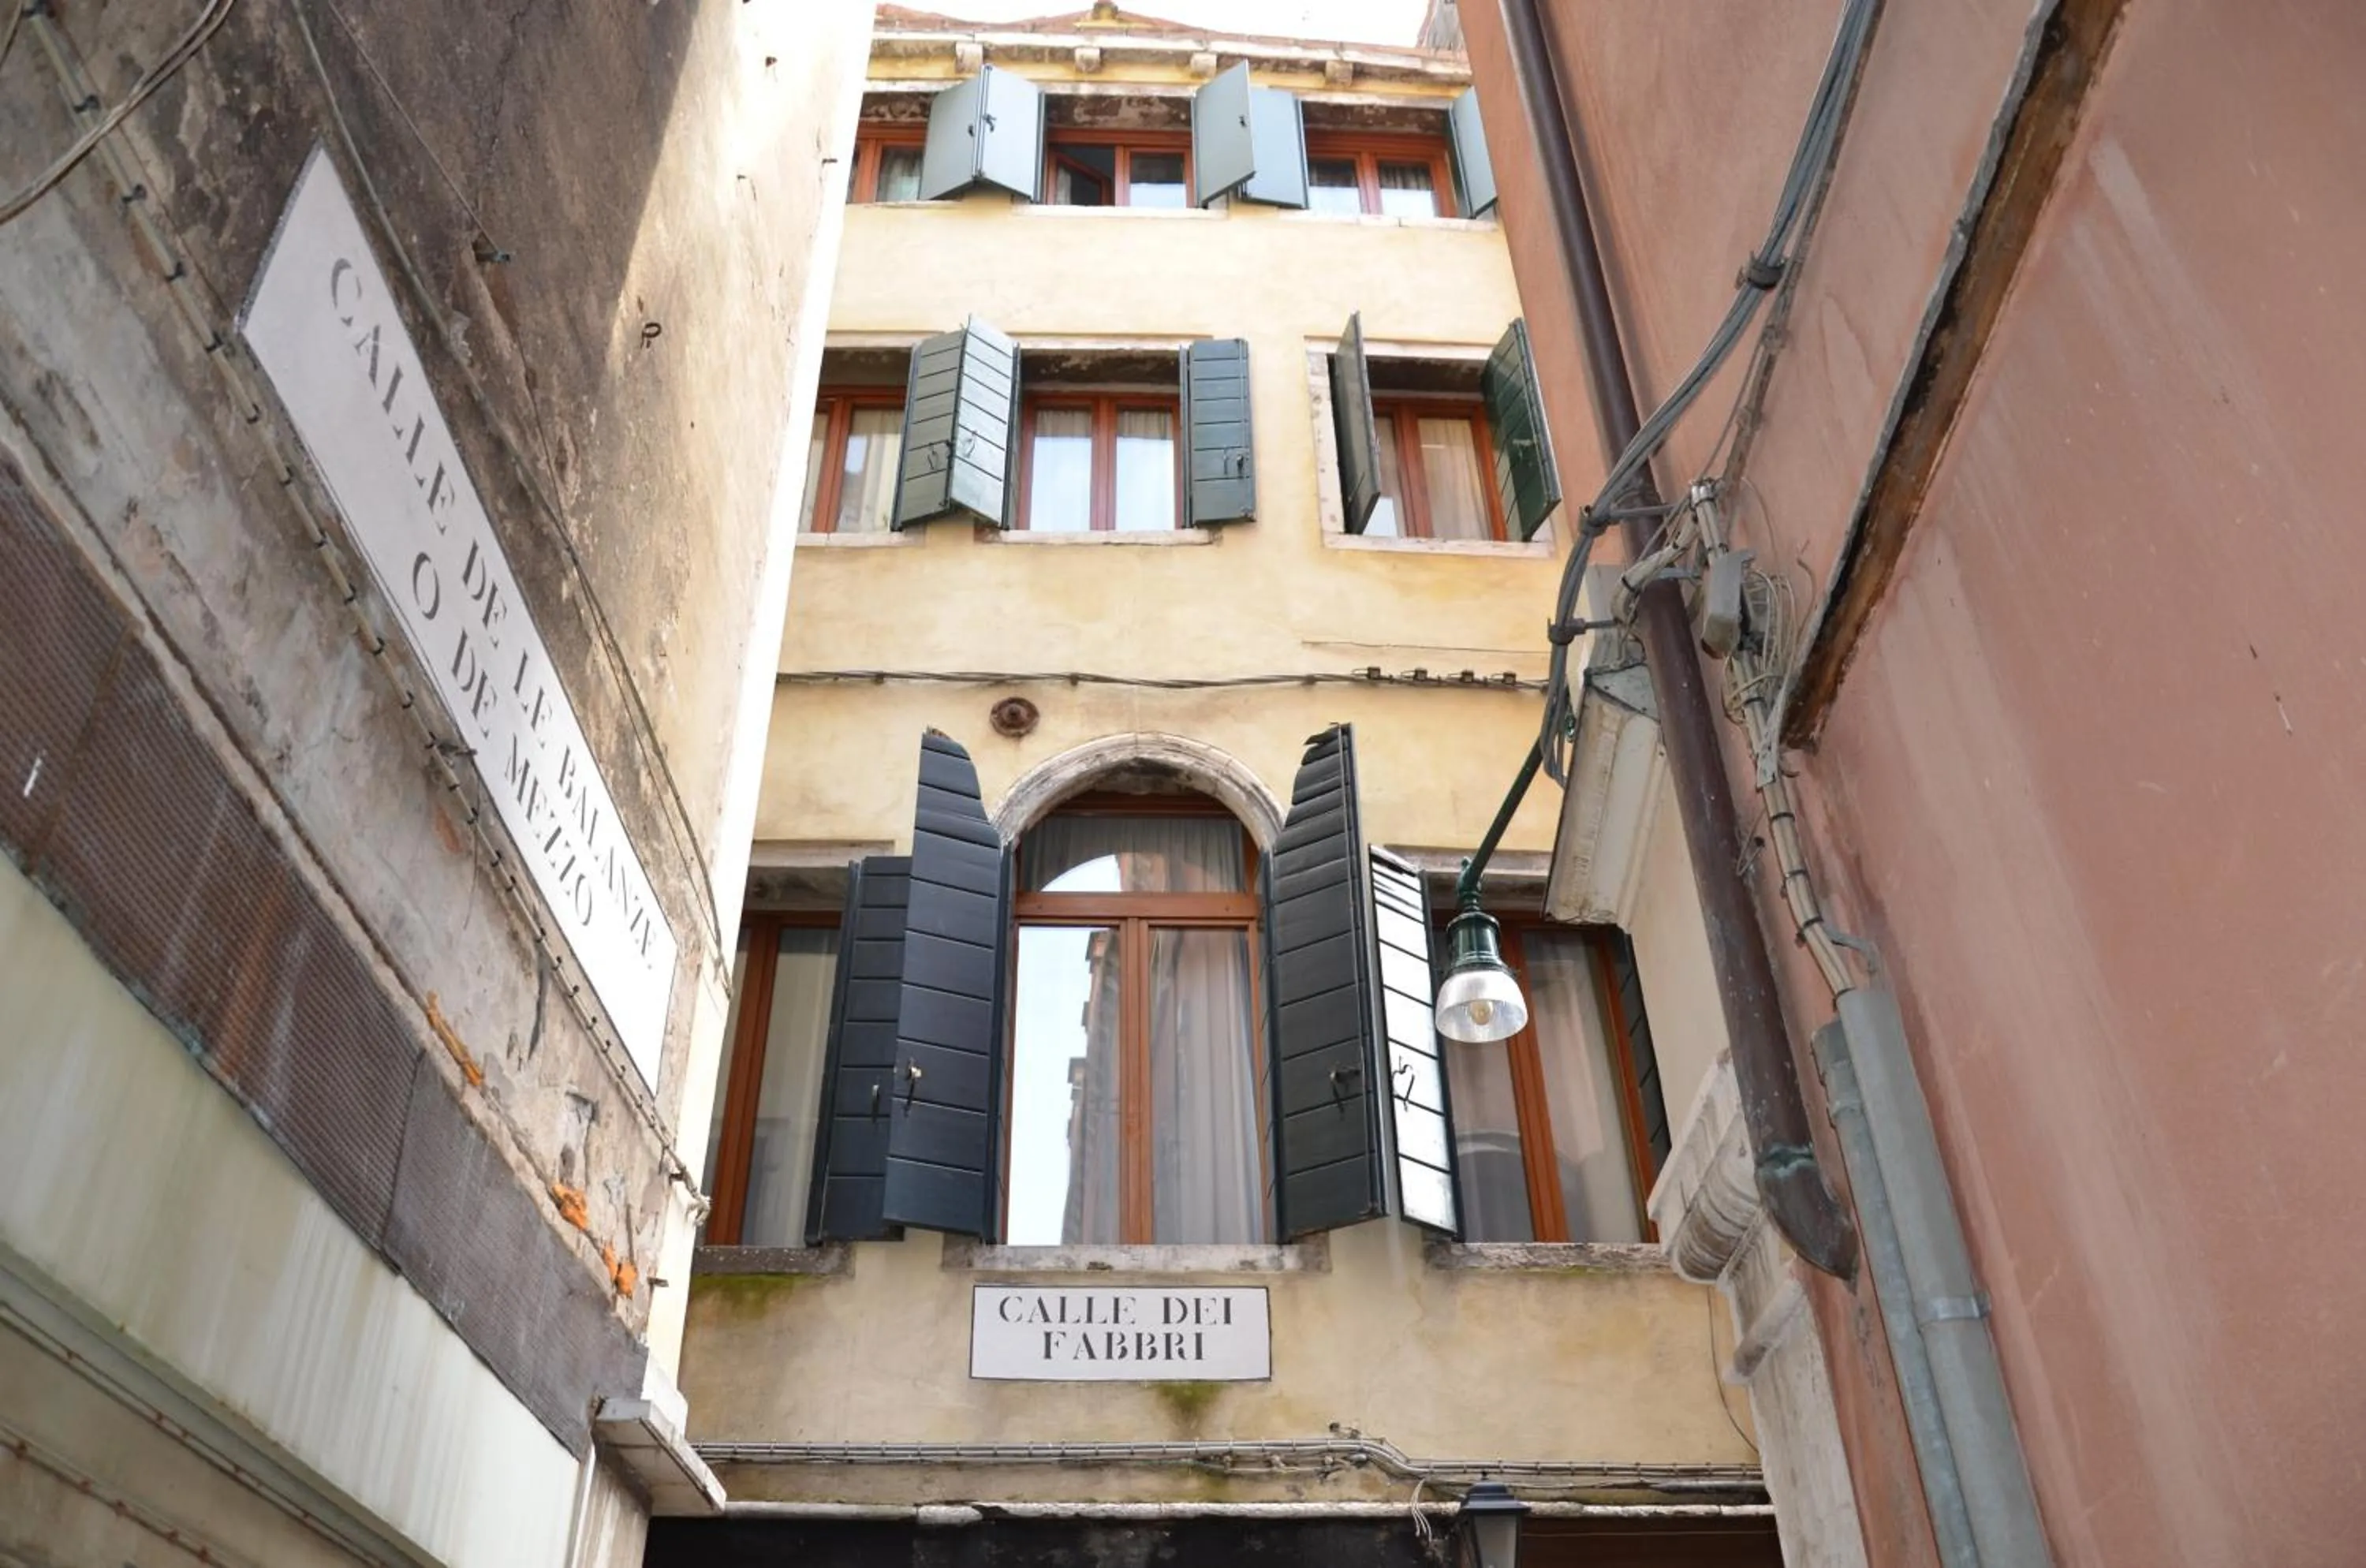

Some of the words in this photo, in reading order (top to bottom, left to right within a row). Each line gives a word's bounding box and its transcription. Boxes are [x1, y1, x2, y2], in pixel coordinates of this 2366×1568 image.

[330, 257, 455, 536] CALLE
[462, 538, 507, 650] DE
[513, 648, 552, 750] LE
[558, 745, 657, 970] BALANZE
[413, 551, 440, 621] O
[451, 627, 498, 740] DE
[504, 733, 592, 927] MEZZO
[998, 1295, 1137, 1324] CALLE
[1162, 1296, 1233, 1325] DEI
[1042, 1331, 1207, 1361] FABBRI
